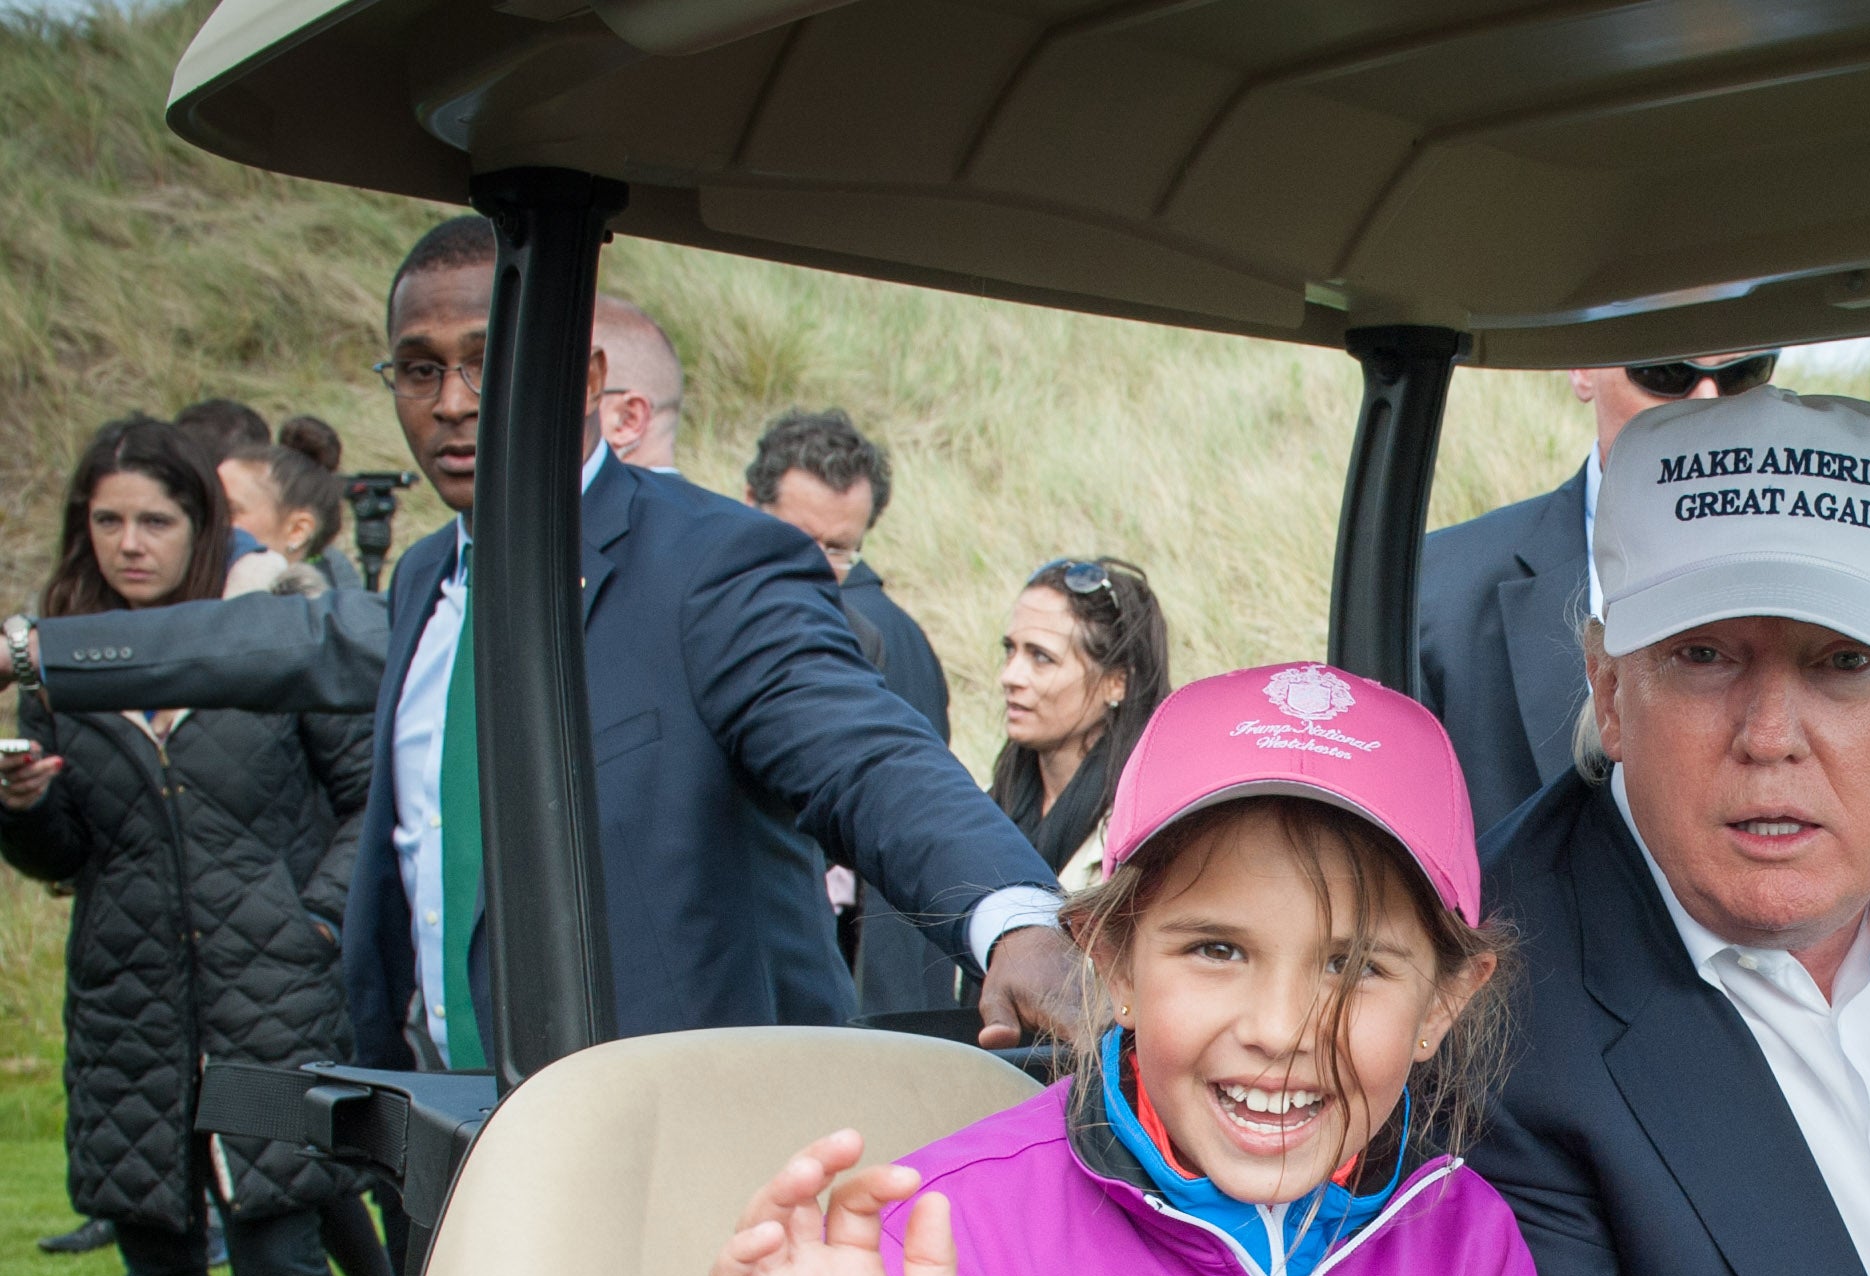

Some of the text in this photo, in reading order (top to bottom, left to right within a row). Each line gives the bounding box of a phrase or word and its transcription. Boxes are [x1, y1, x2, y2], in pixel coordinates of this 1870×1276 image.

[1657, 448, 1753, 485] MAKE
[1675, 487, 1785, 522] GREAT
[1230, 719, 1381, 752] Trump National
[1256, 735, 1352, 760] Westchester
